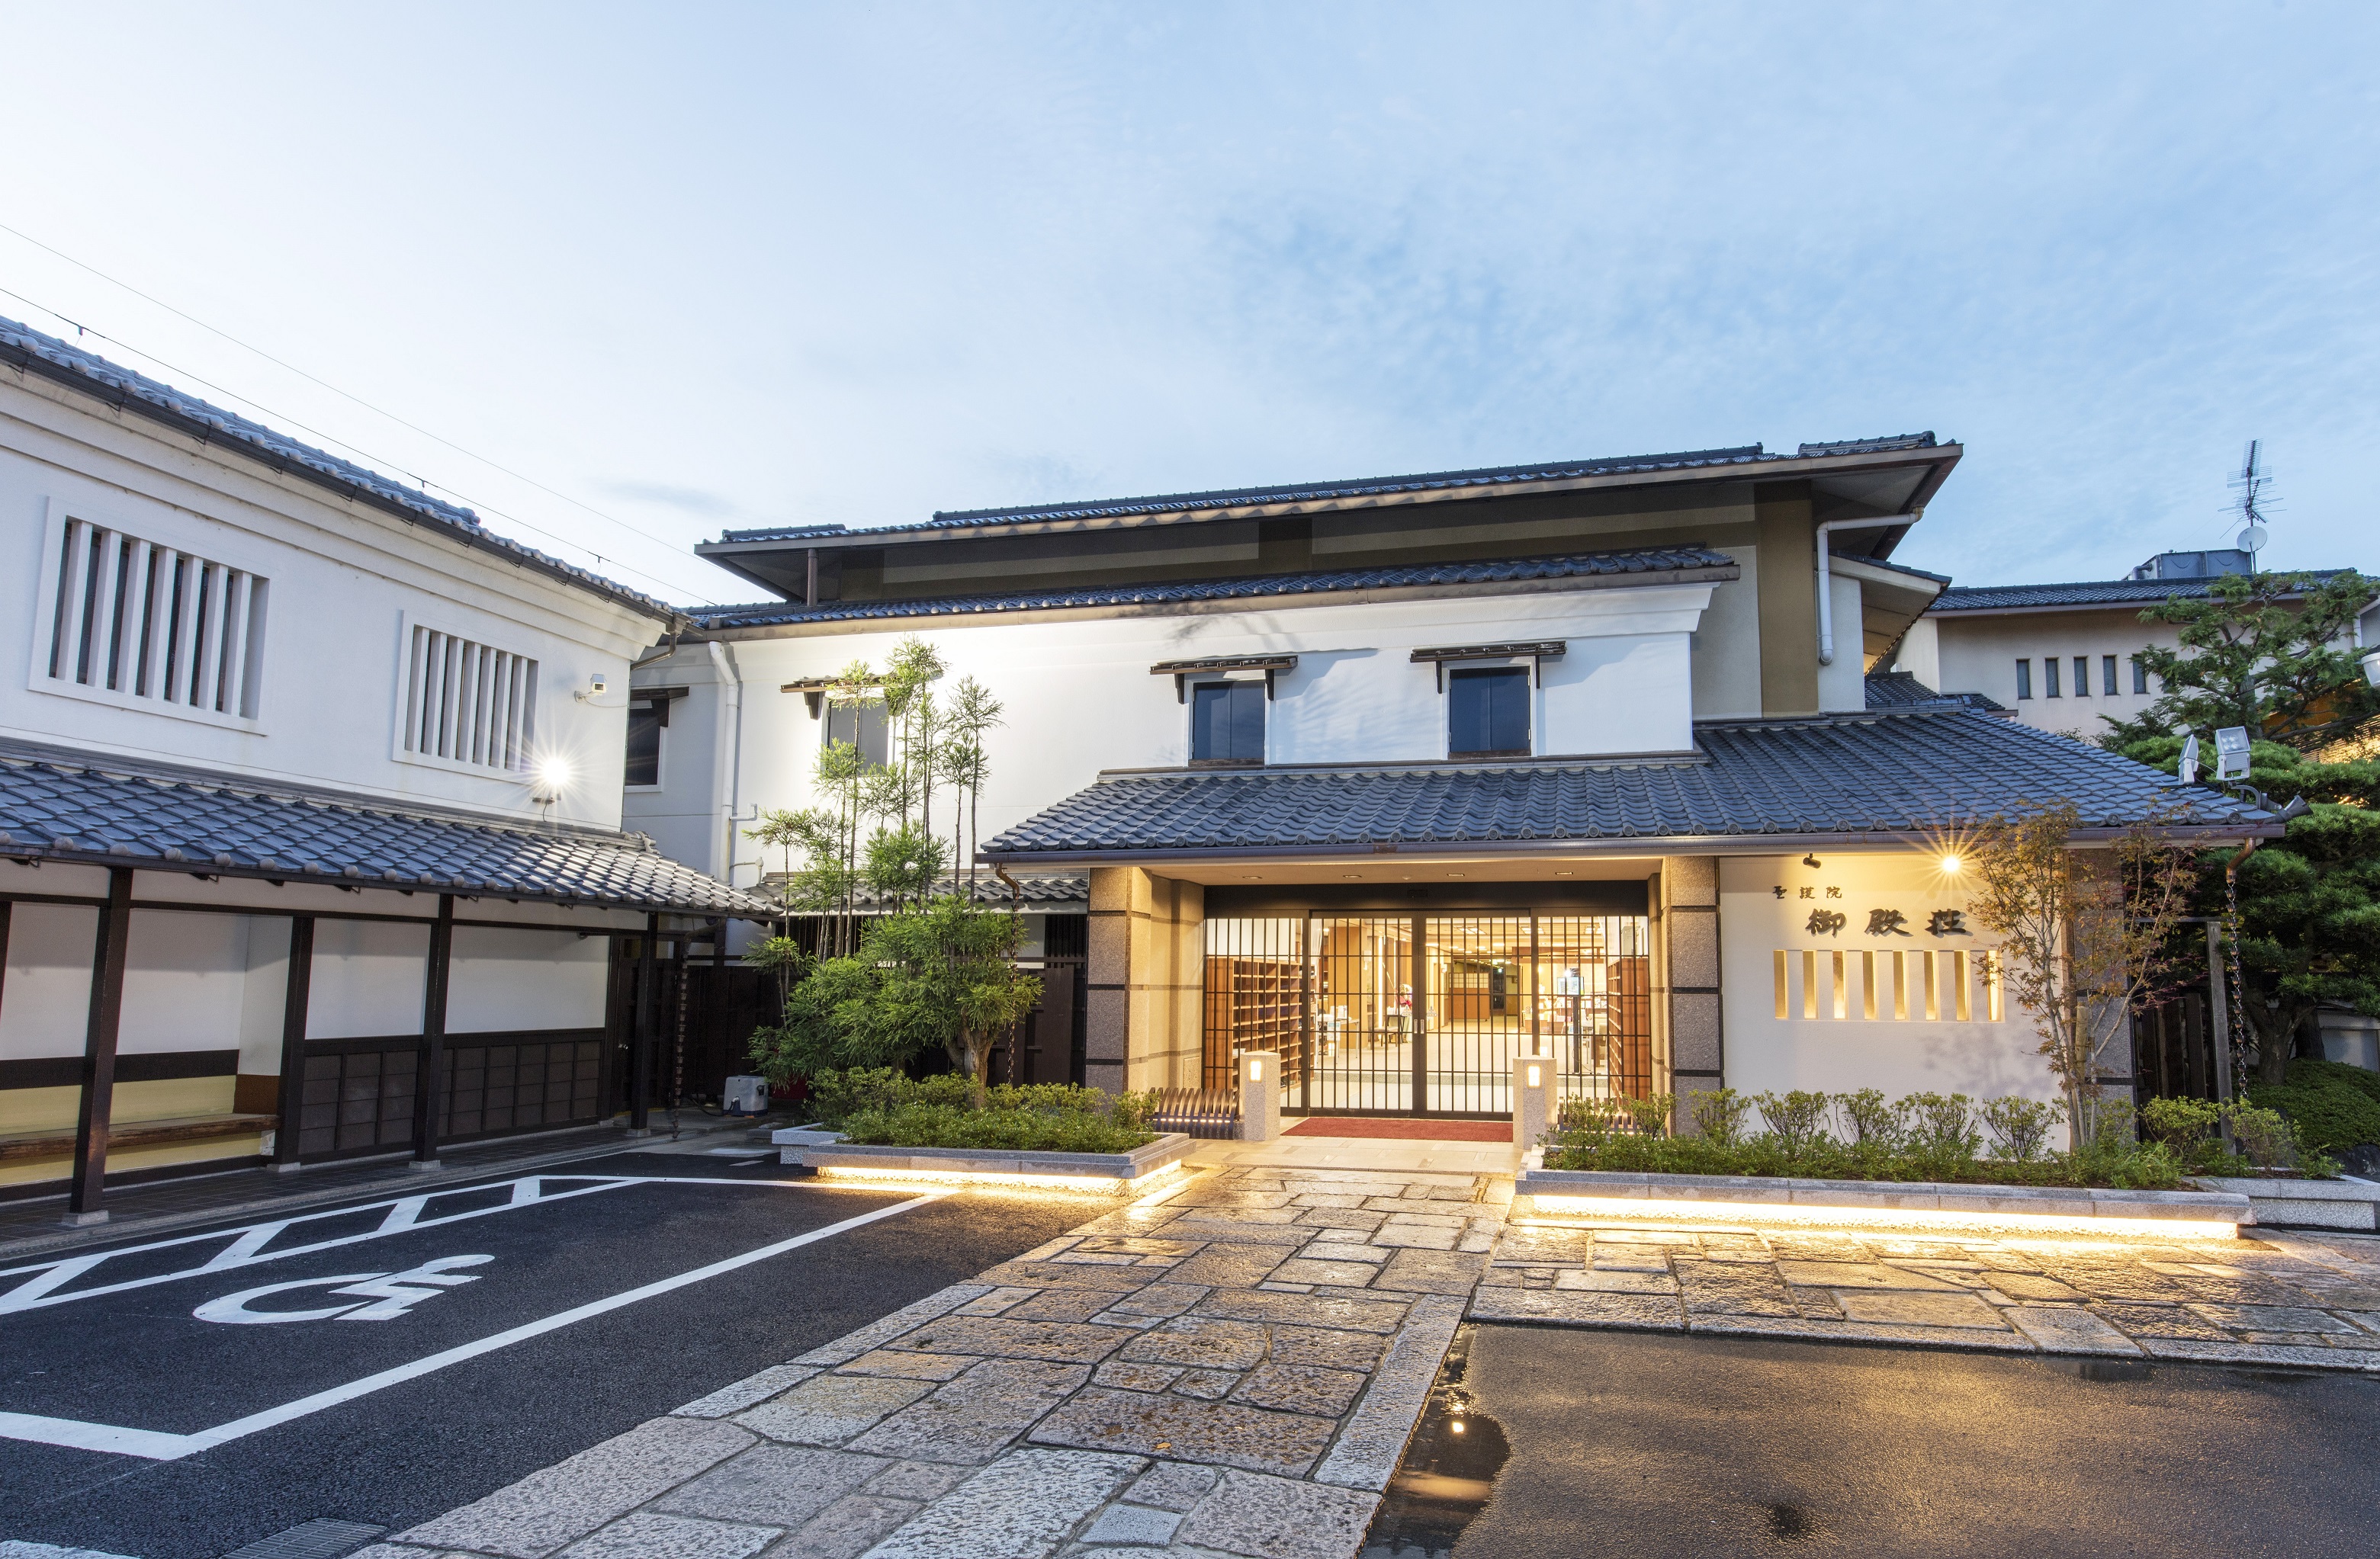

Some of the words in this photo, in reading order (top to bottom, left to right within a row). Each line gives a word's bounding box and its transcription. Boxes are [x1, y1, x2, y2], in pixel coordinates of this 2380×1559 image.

[1772, 885, 1842, 900] 聖護院
[1805, 908, 1967, 936] 御殿荘
